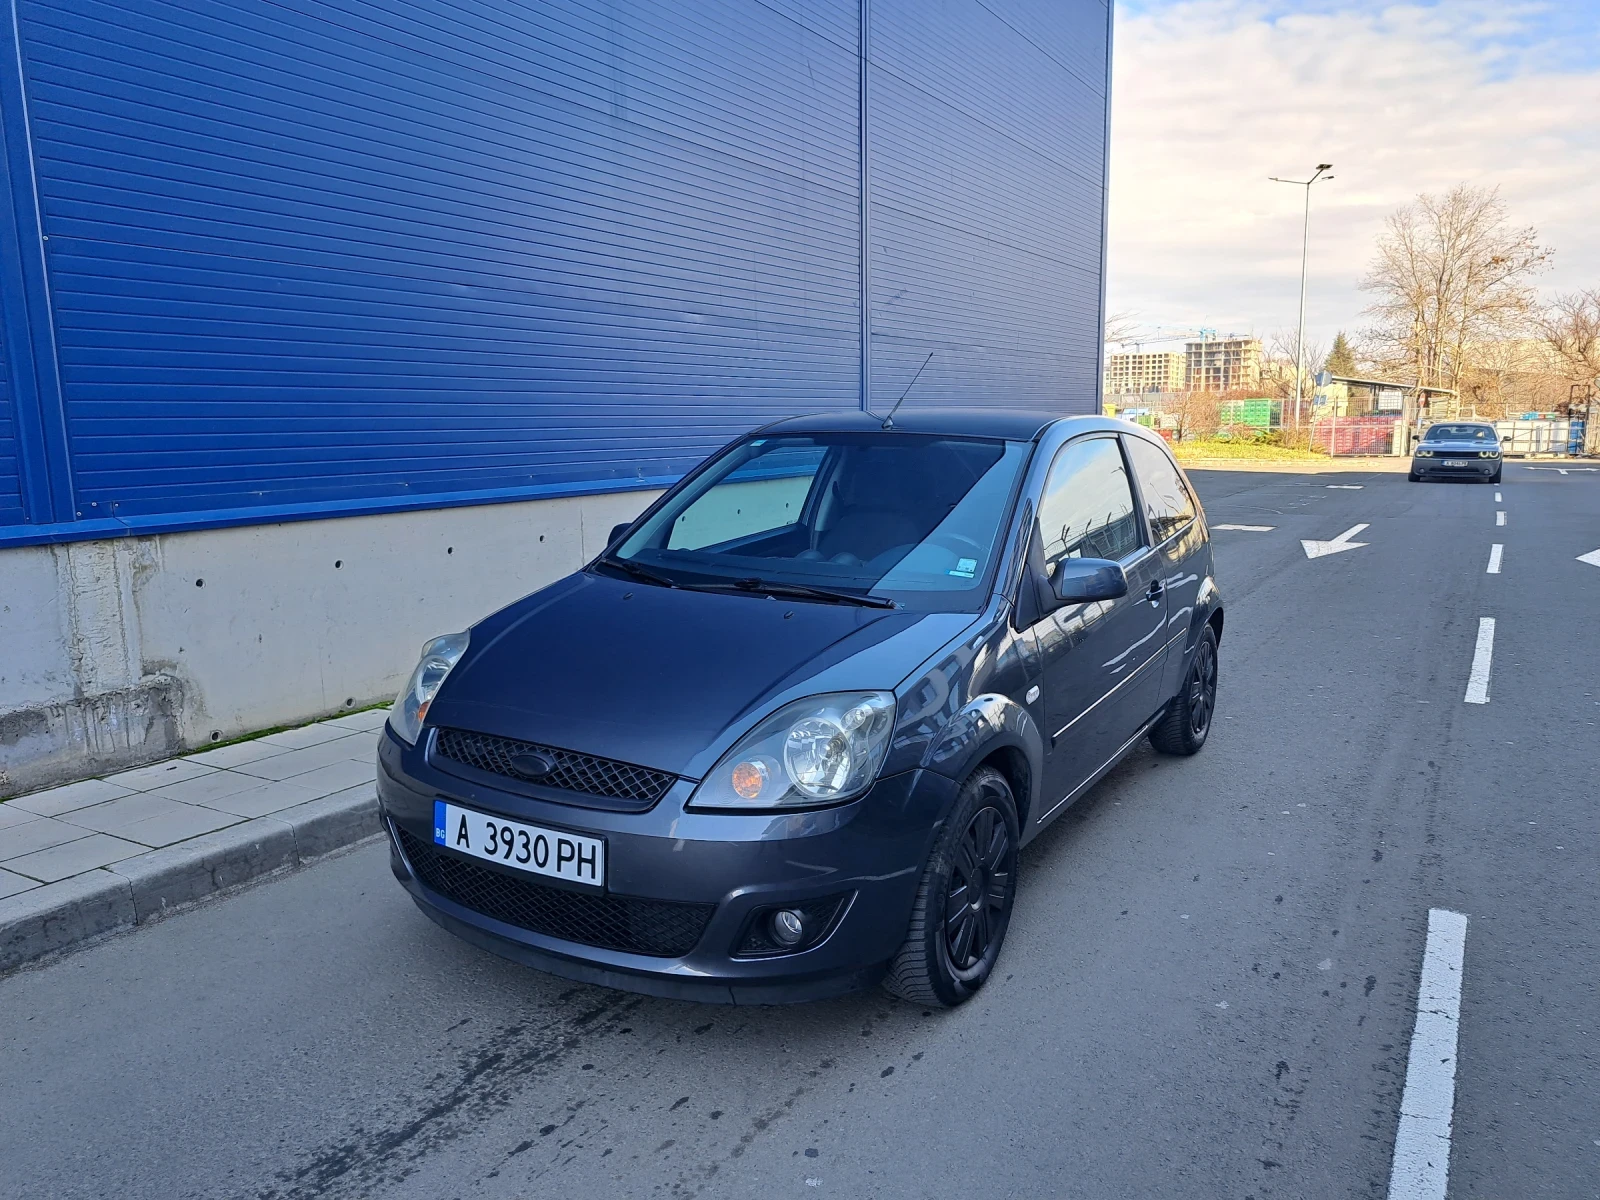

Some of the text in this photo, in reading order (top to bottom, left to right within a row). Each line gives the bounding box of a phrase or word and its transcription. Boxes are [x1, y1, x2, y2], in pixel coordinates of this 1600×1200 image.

[435, 828, 446, 839] BG
[456, 814, 597, 879] A 3930 PH
